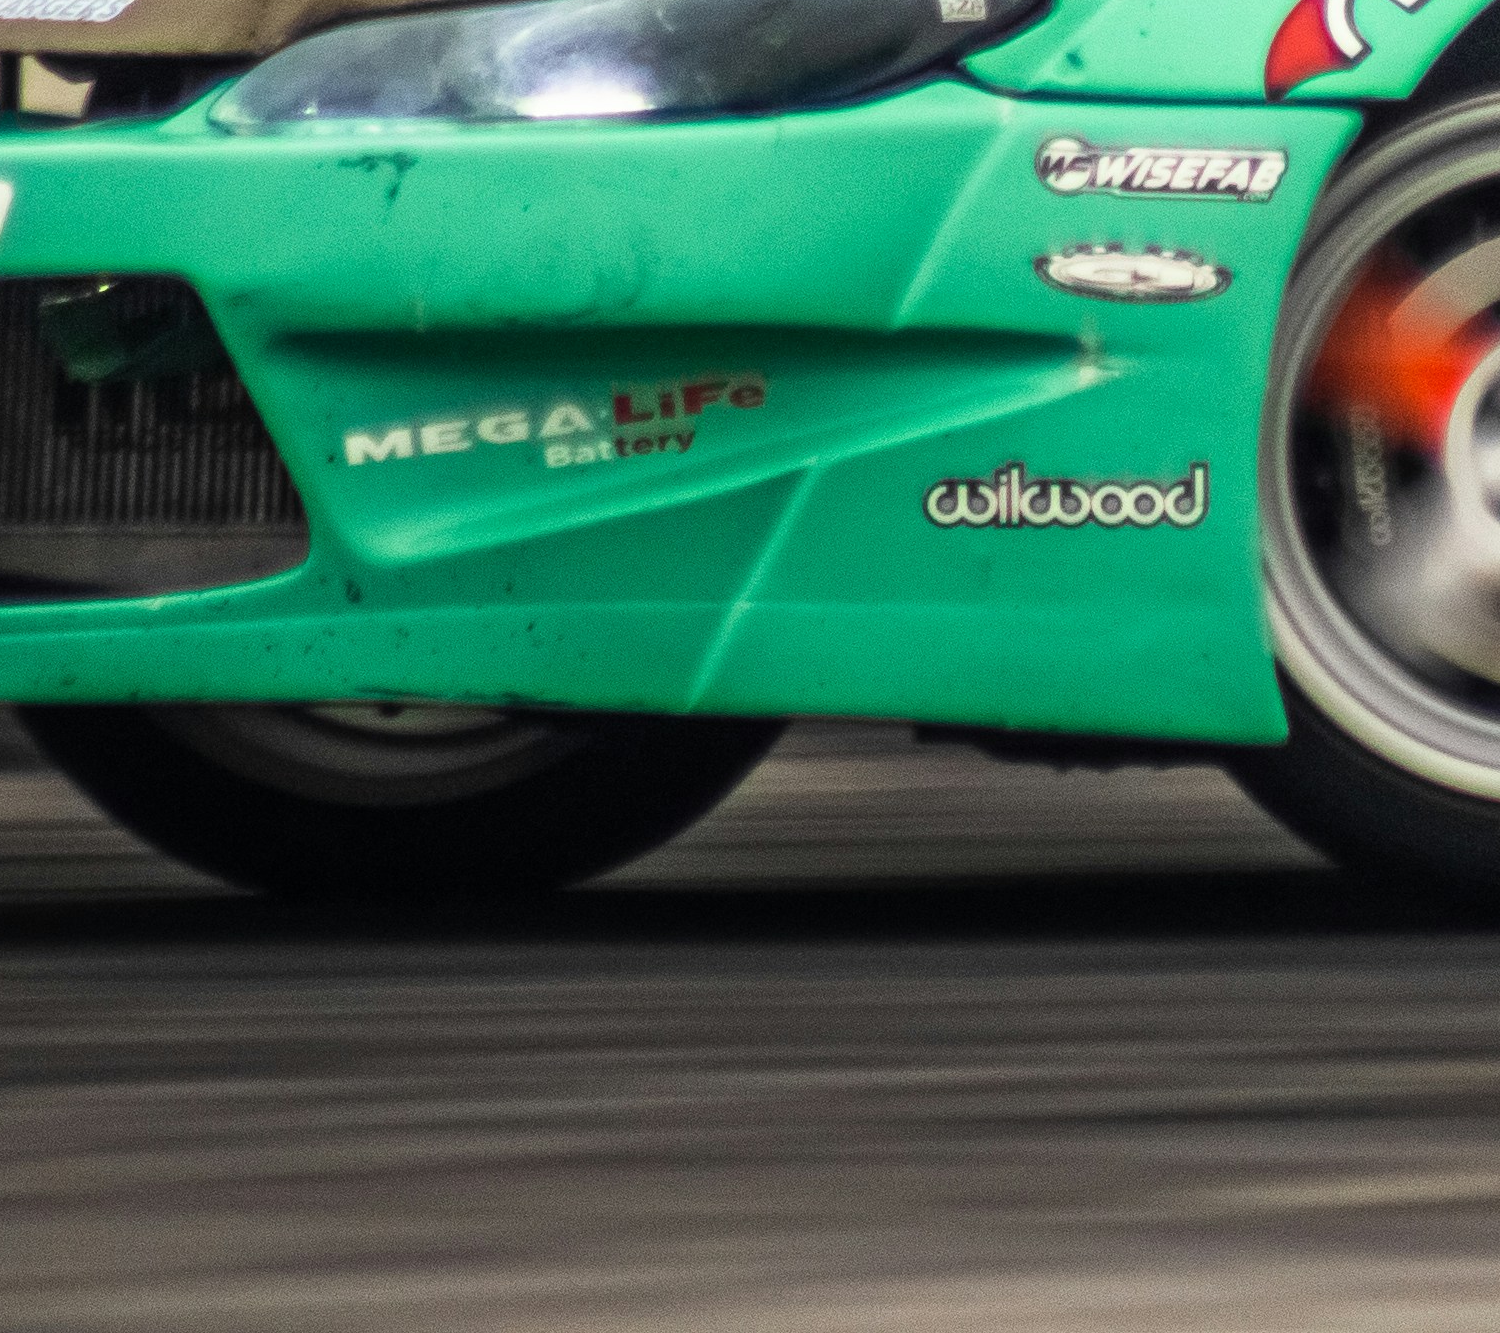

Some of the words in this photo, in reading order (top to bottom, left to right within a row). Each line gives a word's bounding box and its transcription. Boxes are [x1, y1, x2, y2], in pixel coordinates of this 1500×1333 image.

[1097, 154, 1285, 192] WISEFAB
[343, 402, 596, 466] MEGA
[543, 431, 697, 469] Battery
[922, 463, 1210, 529] wilwood
